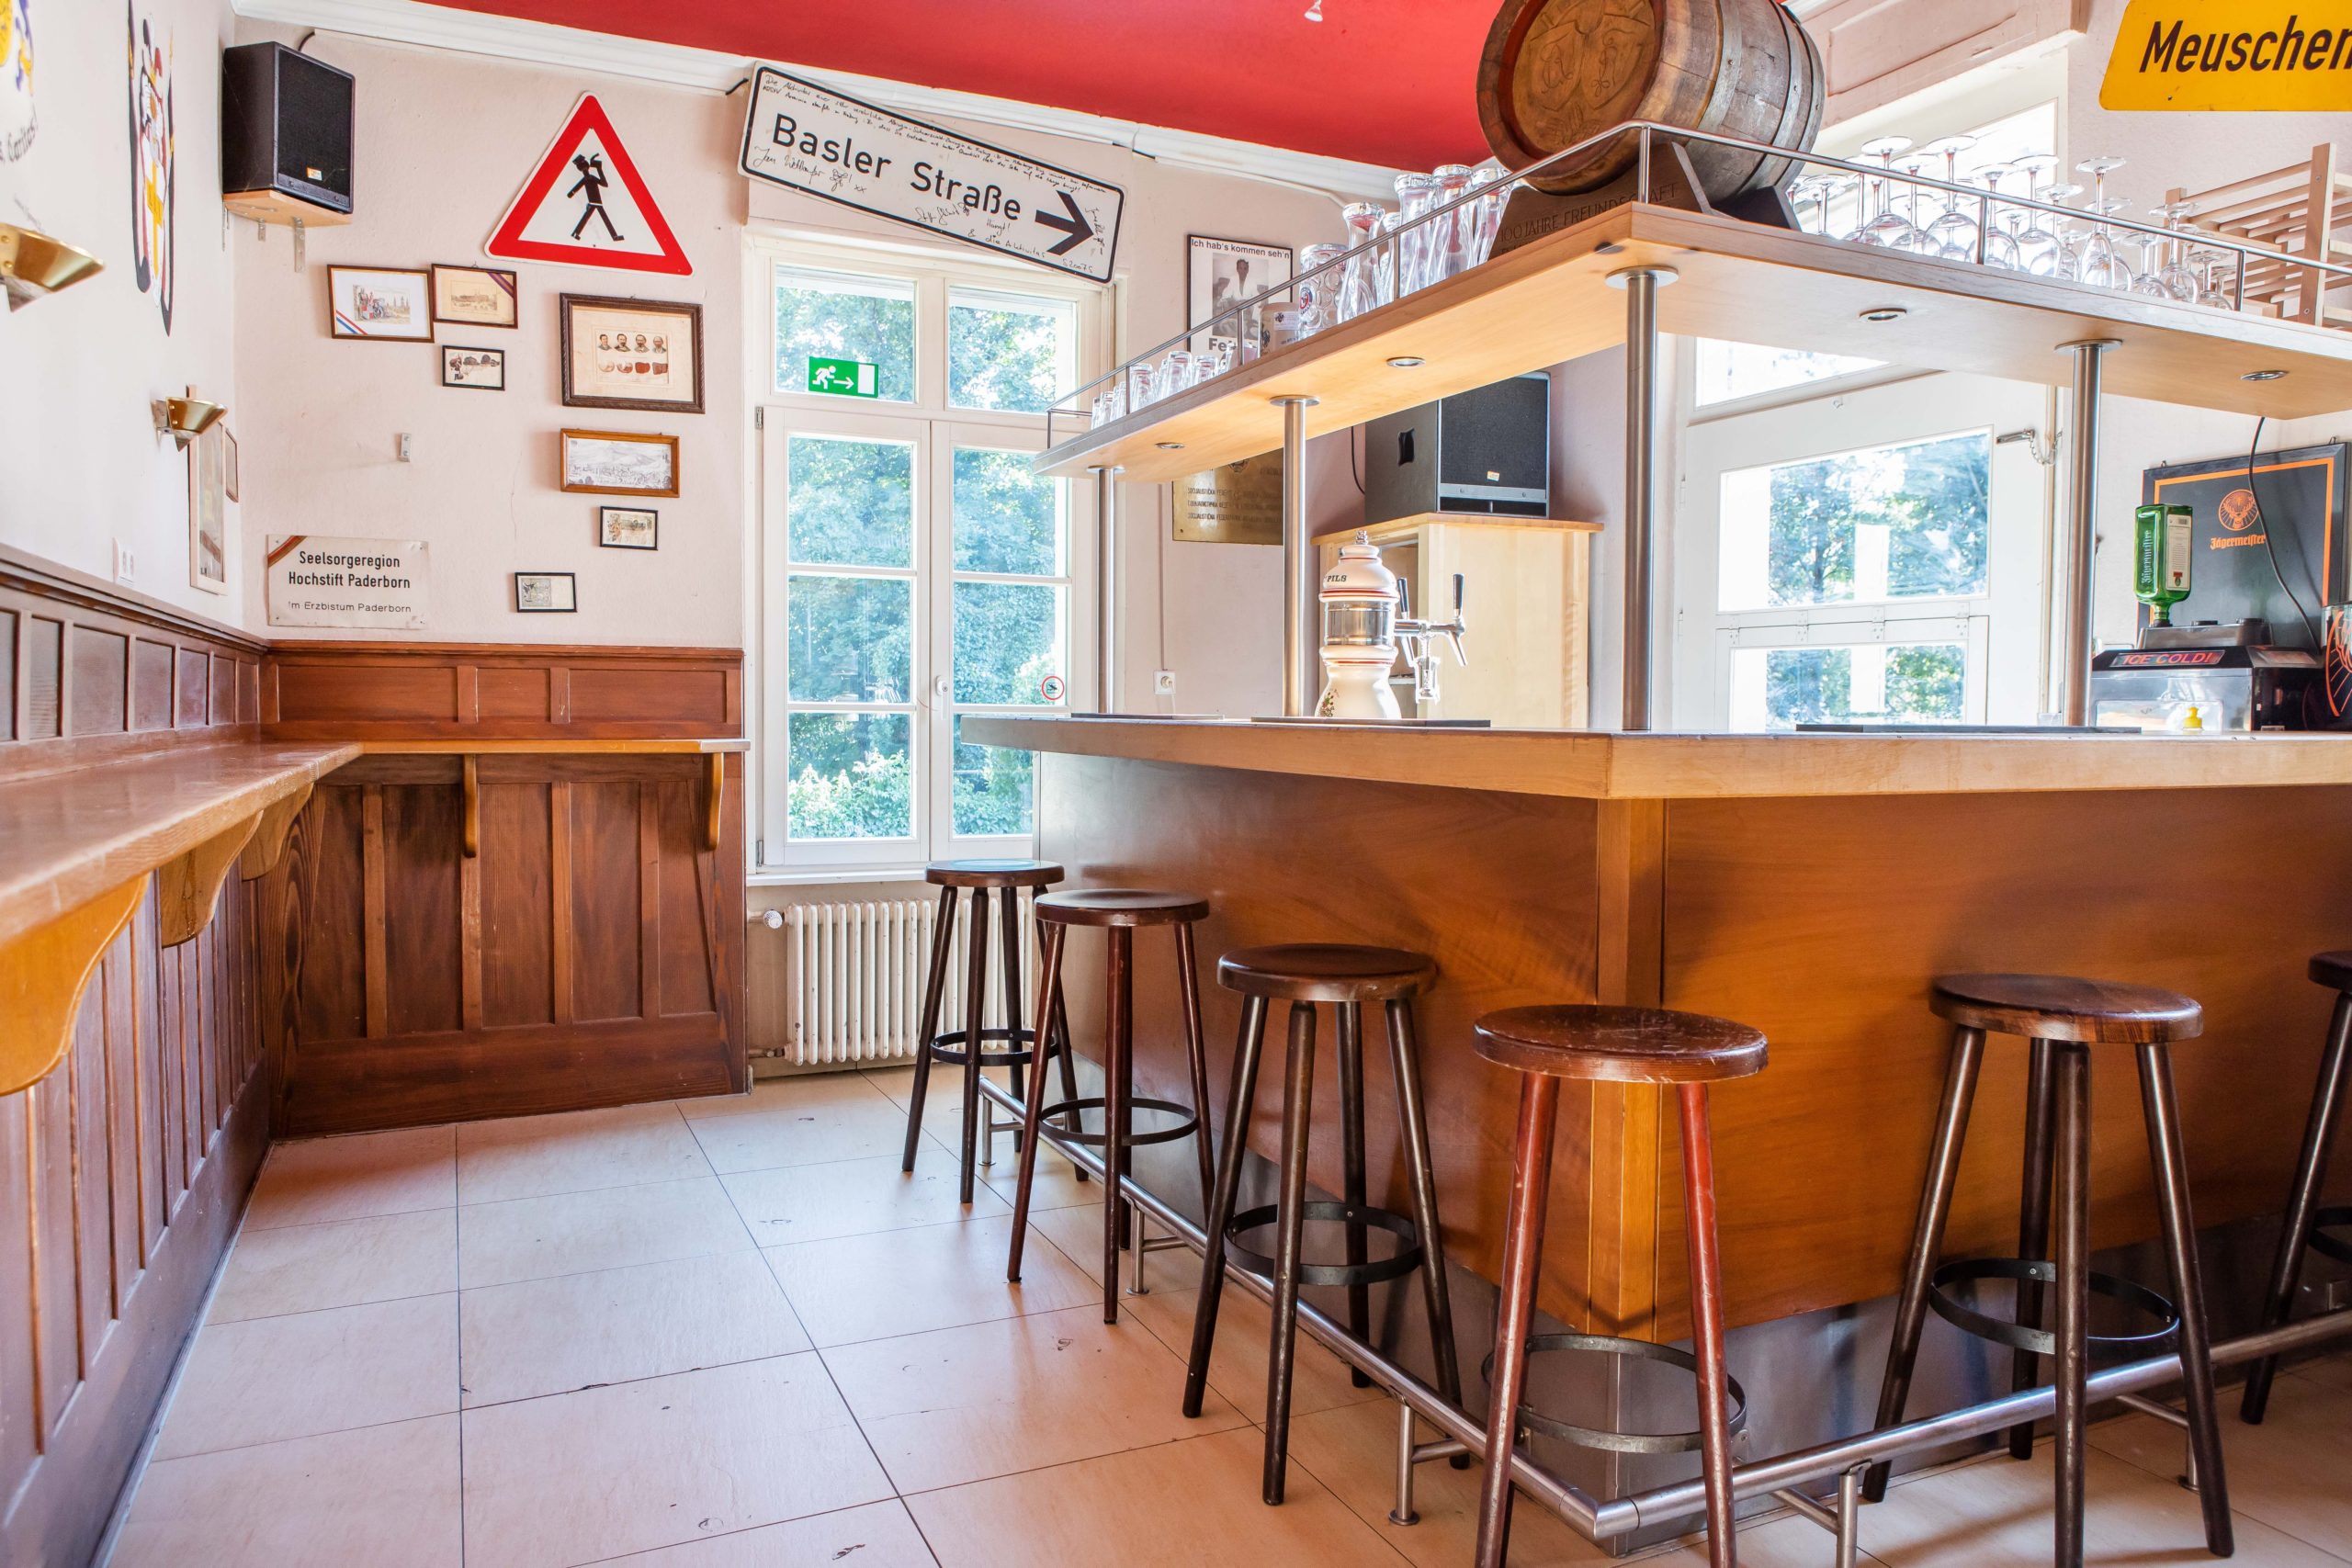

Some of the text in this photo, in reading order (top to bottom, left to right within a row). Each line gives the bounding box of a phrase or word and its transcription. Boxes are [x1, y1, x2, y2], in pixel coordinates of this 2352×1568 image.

[773, 114, 892, 179] Basler
[910, 161, 1022, 221] Straße
[1523, 214, 1559, 237] JAHRE
[1191, 238, 1290, 259] Ich hab's kommen seh'n
[300, 551, 400, 570] Seelsorgeregion
[288, 571, 411, 589] Hochstift Paderborn
[304, 602, 355, 612] Erzbistum
[357, 603, 412, 614] Paderborn
[2122, 652, 2213, 665] ICE COLD!
